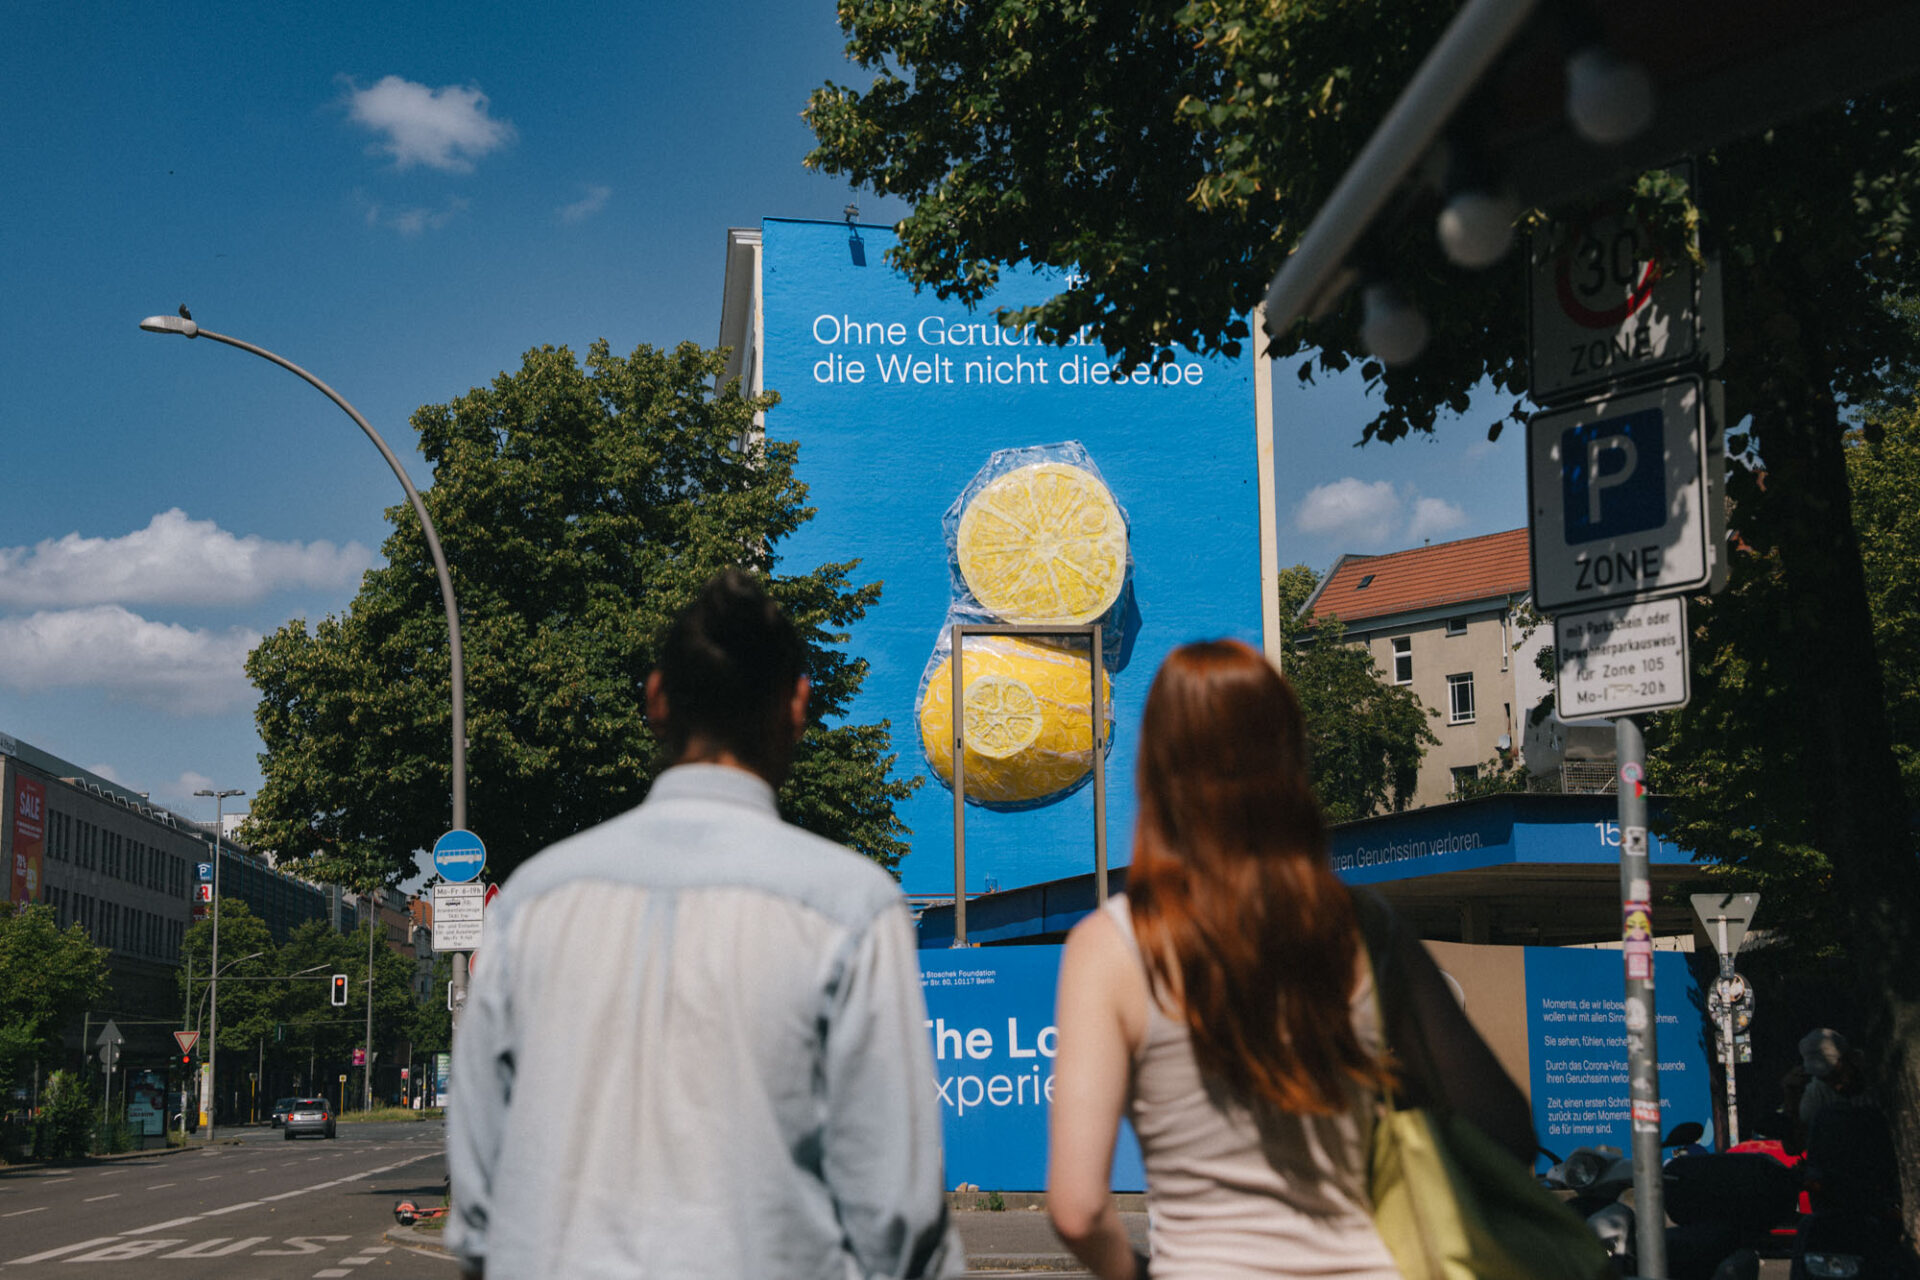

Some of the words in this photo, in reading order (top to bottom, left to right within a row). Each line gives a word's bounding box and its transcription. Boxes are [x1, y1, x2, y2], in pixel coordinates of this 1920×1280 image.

[1577, 228, 1639, 296] 30
[813, 314, 907, 346] Ohne
[1571, 325, 1652, 377] ZONE
[814, 353, 865, 384] die
[877, 354, 954, 384] Welt
[965, 353, 1049, 384] nicht
[1588, 434, 1638, 524] P
[1575, 546, 1660, 591] ZONE
[1647, 612, 1670, 627] oder
[1603, 663, 1636, 679] Zone
[1642, 656, 1665, 673] 105
[20, 791, 40, 820] SALE
[1356, 841, 1428, 869] Geruchssinn
[1430, 832, 1483, 856] verloren.
[954, 978, 974, 986] 10117
[1580, 999, 1590, 1010] die
[1592, 1000, 1601, 1010] wir
[1543, 1011, 1566, 1022] wollen
[1568, 1012, 1577, 1022] wir
[1580, 1012, 1589, 1022] mit
[1591, 1012, 1607, 1022] allen
[1544, 1035, 1557, 1047] Sie
[1545, 1060, 1566, 1071] Durch
[1569, 1060, 1581, 1071] das
[1566, 1072, 1608, 1084] Geruchssinn
[1547, 1098, 1563, 1109] Zeit,
[1564, 1098, 1582, 1108] einen
[1585, 1098, 1605, 1108] ersten
[1548, 1110, 1571, 1121] zurück
[1572, 1111, 1582, 1121] zu
[1583, 1110, 1596, 1121] den
[1549, 1123, 1560, 1134] die
[1561, 1123, 1571, 1134] für
[1573, 1123, 1595, 1134] immer
[1596, 1122, 1613, 1134] sind.
[60, 1235, 353, 1263] BUS
